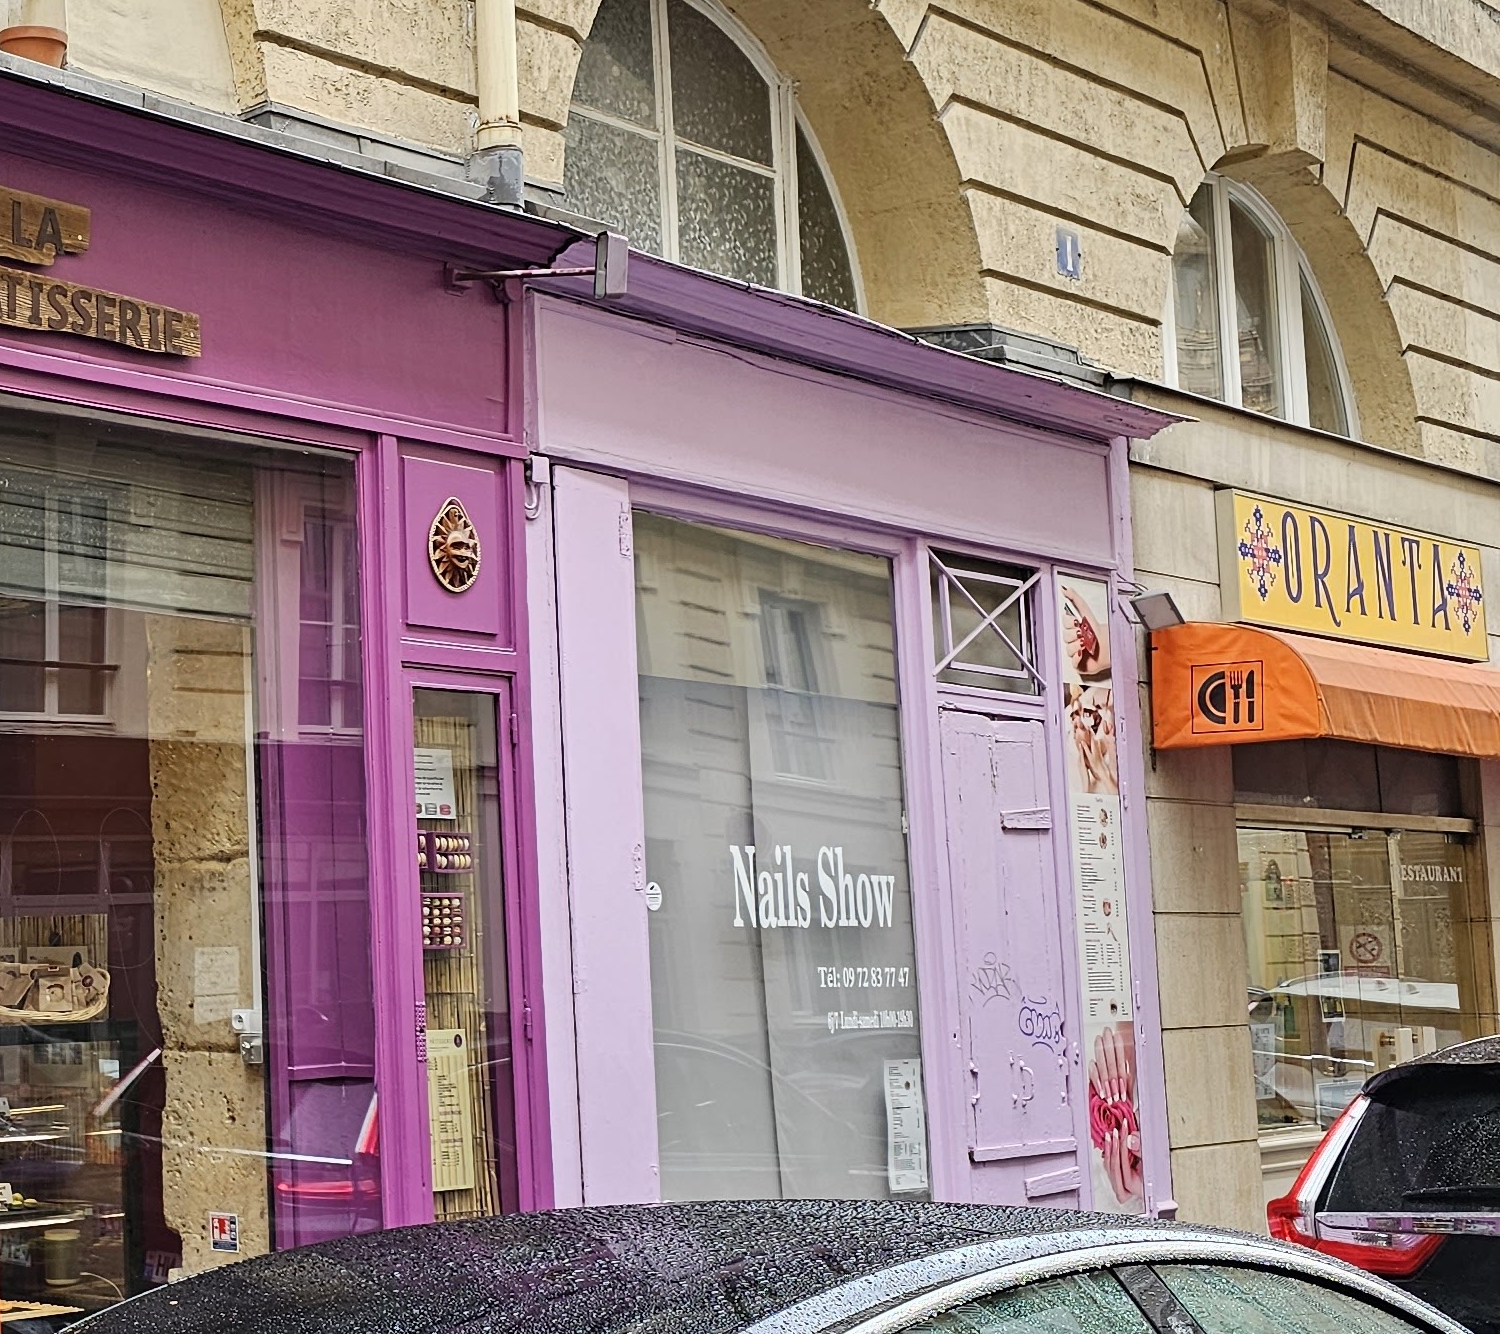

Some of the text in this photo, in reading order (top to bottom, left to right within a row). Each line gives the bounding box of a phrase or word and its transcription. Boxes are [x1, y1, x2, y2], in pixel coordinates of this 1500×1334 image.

[11, 199, 66, 256] LA
[1280, 510, 1452, 631] ORANTA
[729, 844, 895, 929] Nails Show
[817, 966, 910, 988] Tél: 09 72 83 77 47
